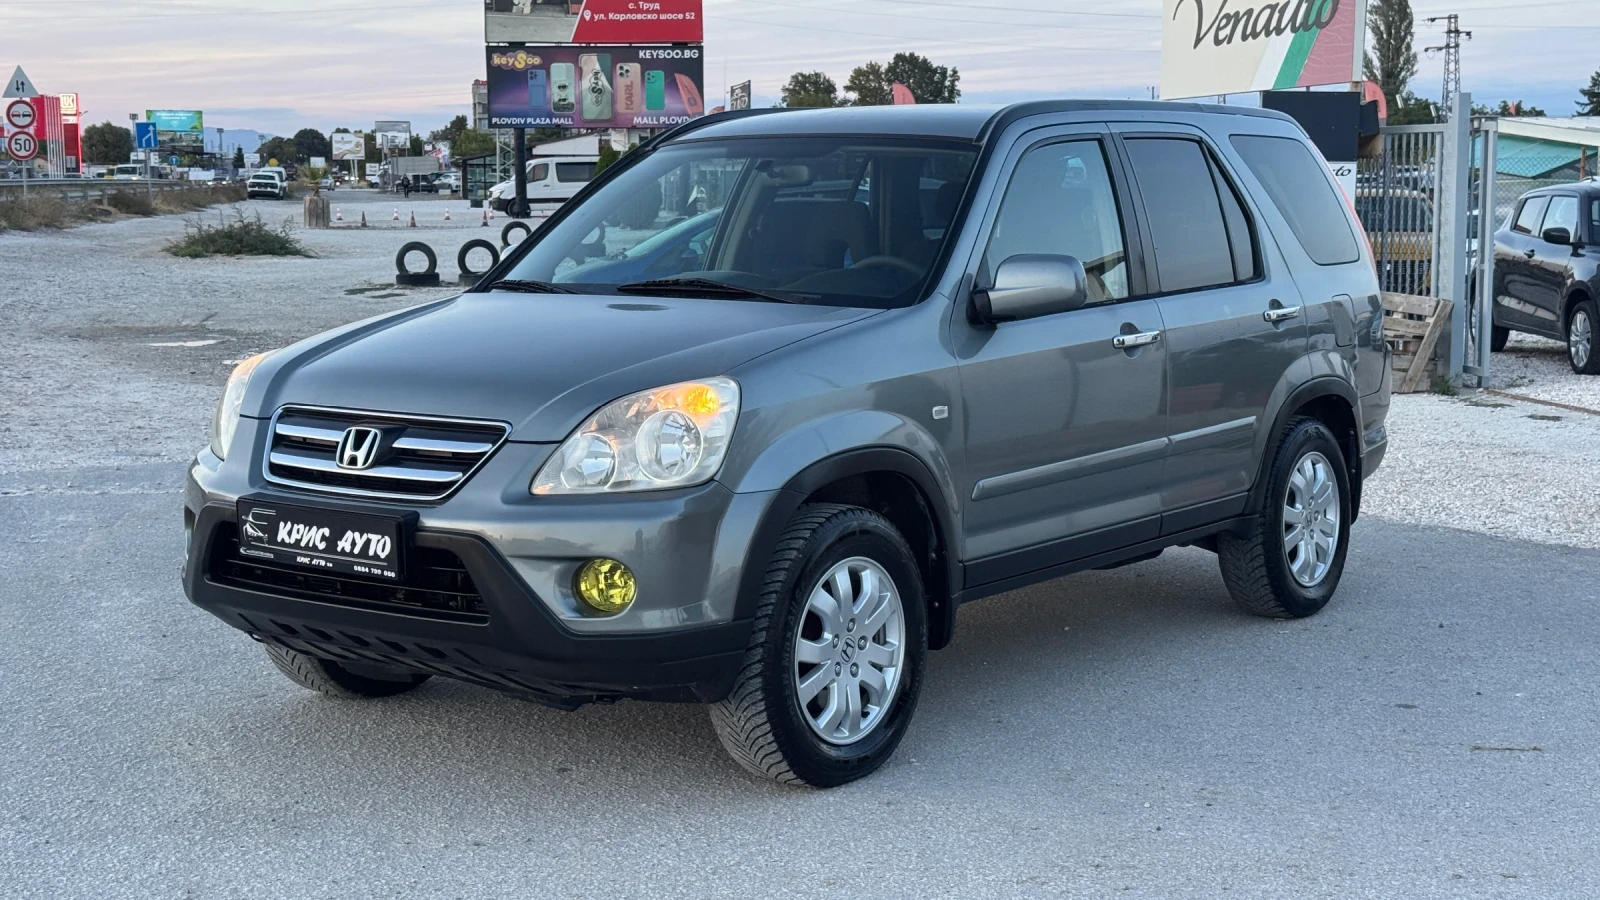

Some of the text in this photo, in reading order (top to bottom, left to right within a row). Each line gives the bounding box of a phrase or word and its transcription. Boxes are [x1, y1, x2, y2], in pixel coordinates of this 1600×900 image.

[638, 2, 660, 10] Труд
[593, 13, 607, 21] ул.
[608, 12, 658, 21] Карловско
[685, 12, 695, 20] 52
[1173, 0, 1339, 50] Venauto
[639, 50, 699, 59] KEYSOO.BG
[624, 82, 634, 111] KARL
[633, 116, 691, 124] MALL PLOVD
[14, 138, 31, 152] 50
[276, 521, 391, 559] КРИС АУТО
